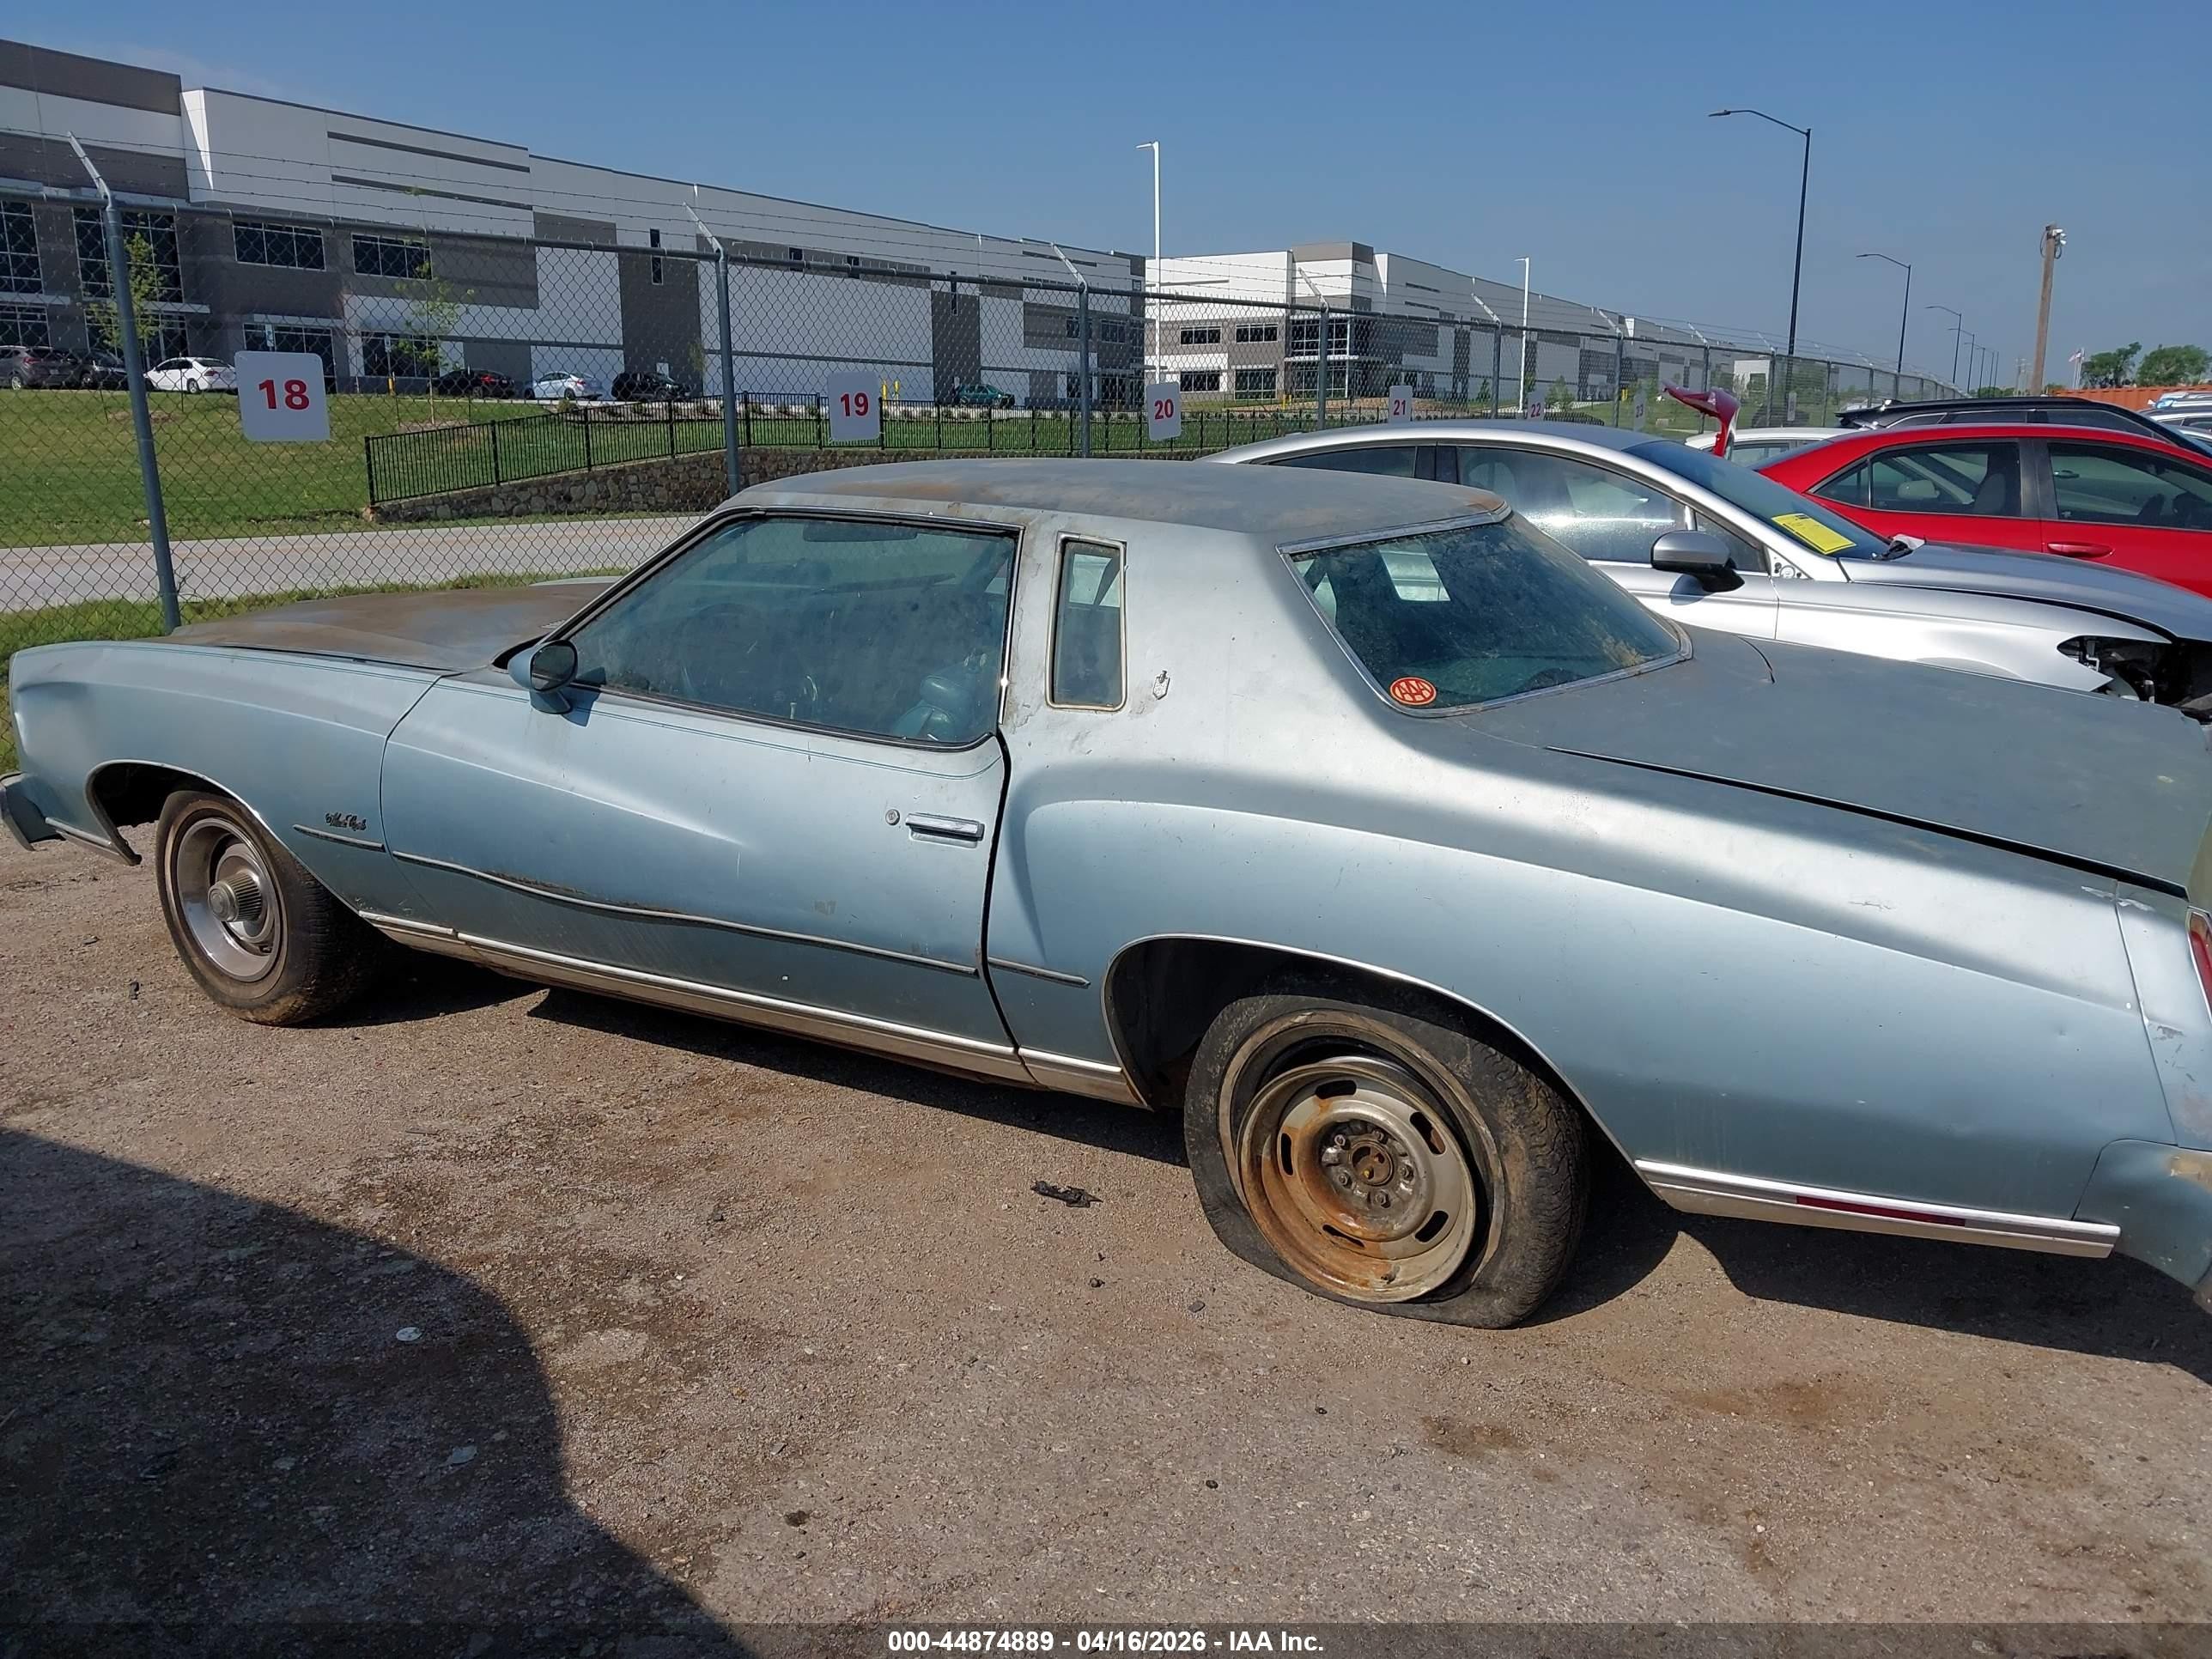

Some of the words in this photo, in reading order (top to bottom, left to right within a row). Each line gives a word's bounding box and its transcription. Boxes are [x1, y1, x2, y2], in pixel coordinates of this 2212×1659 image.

[258, 380, 310, 410] 18
[841, 392, 869, 417] 19
[1154, 398, 1174, 420] 20
[1393, 399, 1407, 416] 21
[1530, 403, 1541, 418] 22
[1393, 679, 1433, 702] AAA
